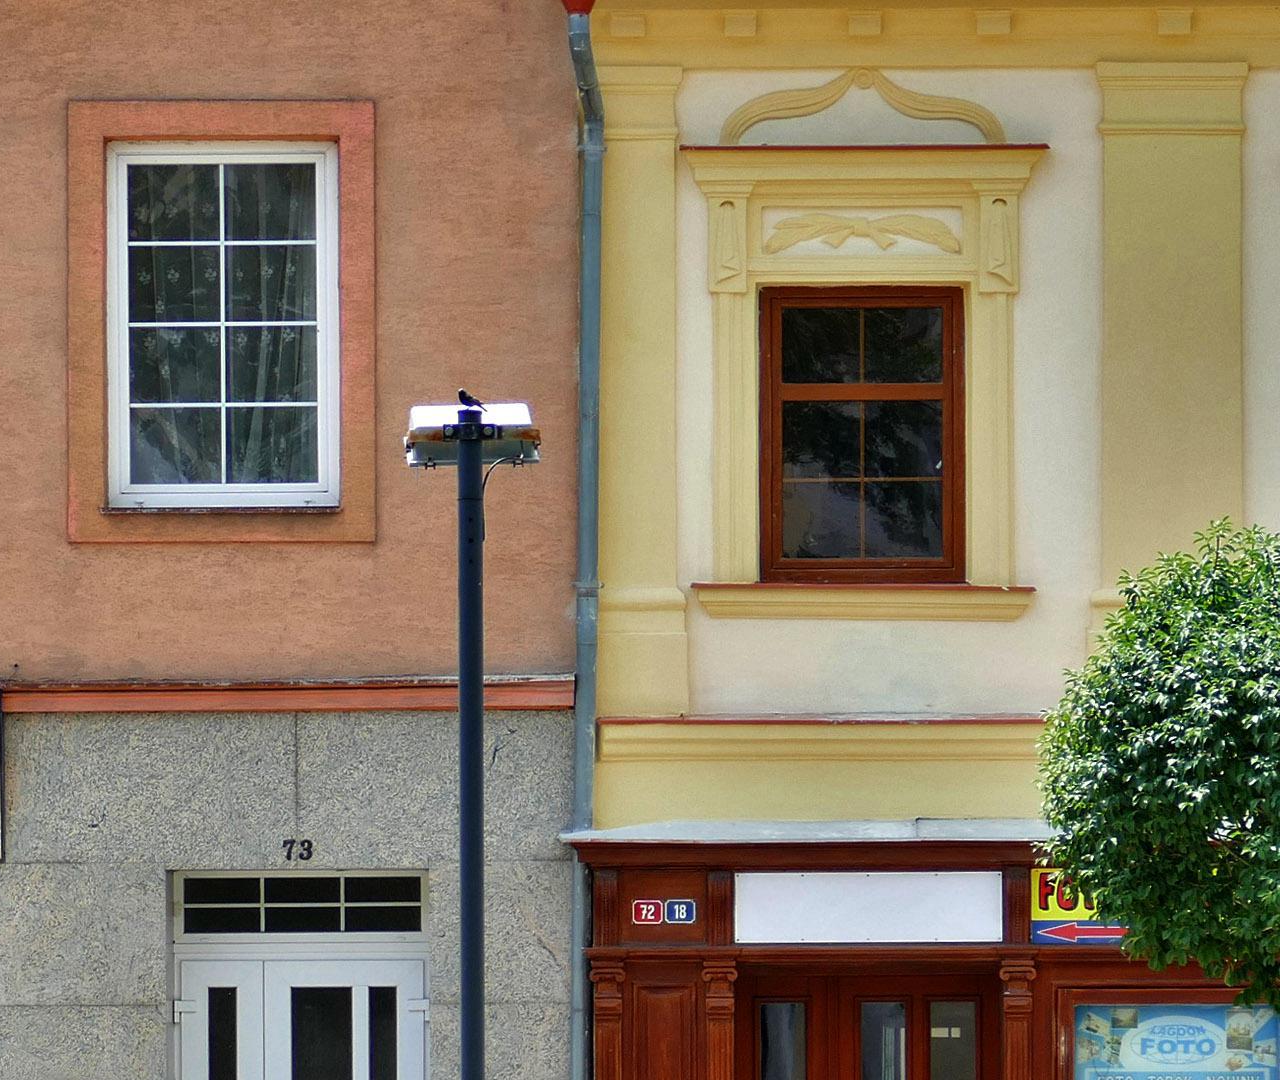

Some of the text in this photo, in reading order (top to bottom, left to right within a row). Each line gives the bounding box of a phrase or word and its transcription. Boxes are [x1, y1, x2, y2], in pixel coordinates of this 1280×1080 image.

[283, 839, 313, 860] 73
[640, 904, 655, 919] 72
[674, 904, 687, 919] 18
[1140, 1038, 1217, 1055] FOTO
